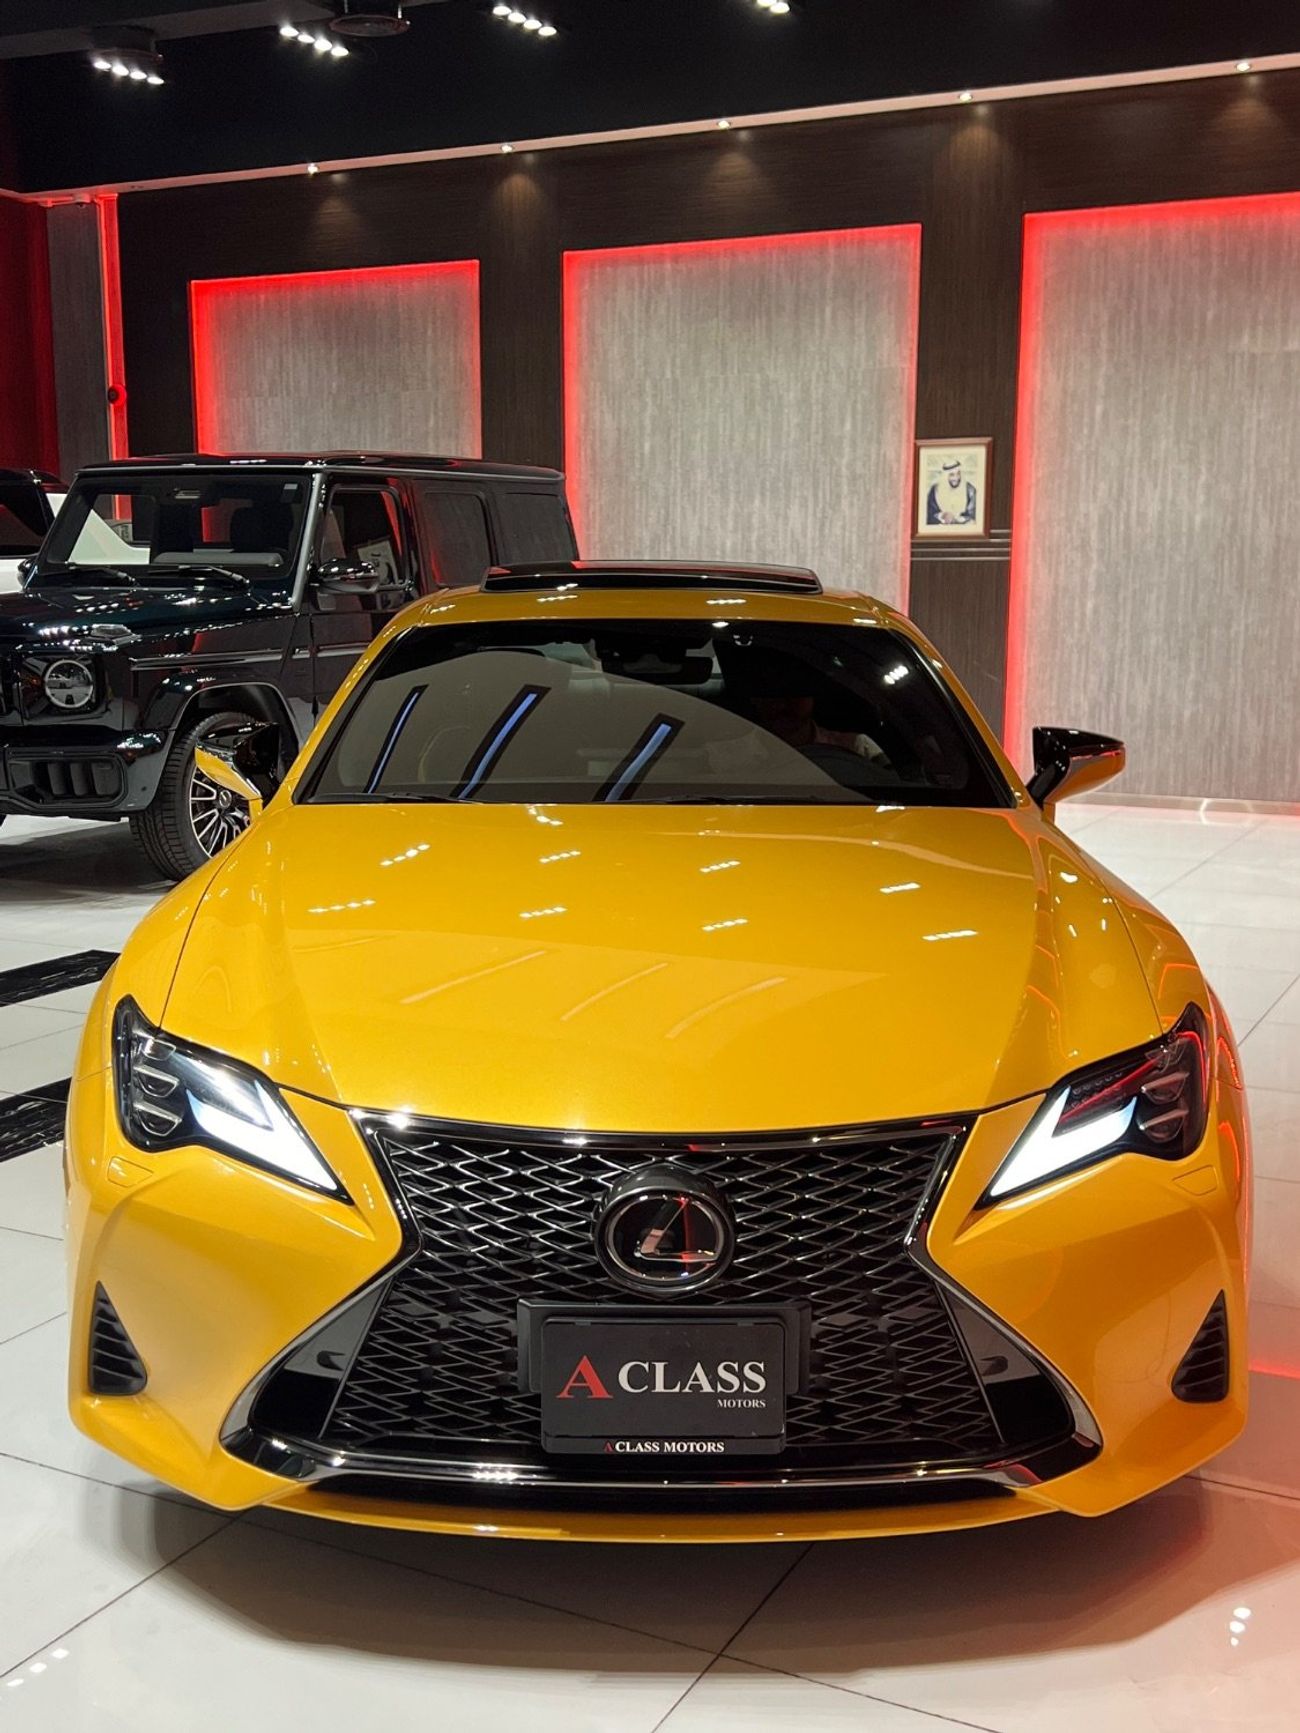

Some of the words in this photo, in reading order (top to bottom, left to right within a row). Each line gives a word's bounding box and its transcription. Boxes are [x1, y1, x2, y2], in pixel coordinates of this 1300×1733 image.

[556, 1355, 613, 1399] A
[618, 1361, 766, 1394] CLASS
[717, 1399, 766, 1408] MOTORS
[663, 1441, 725, 1453] MOTORS
